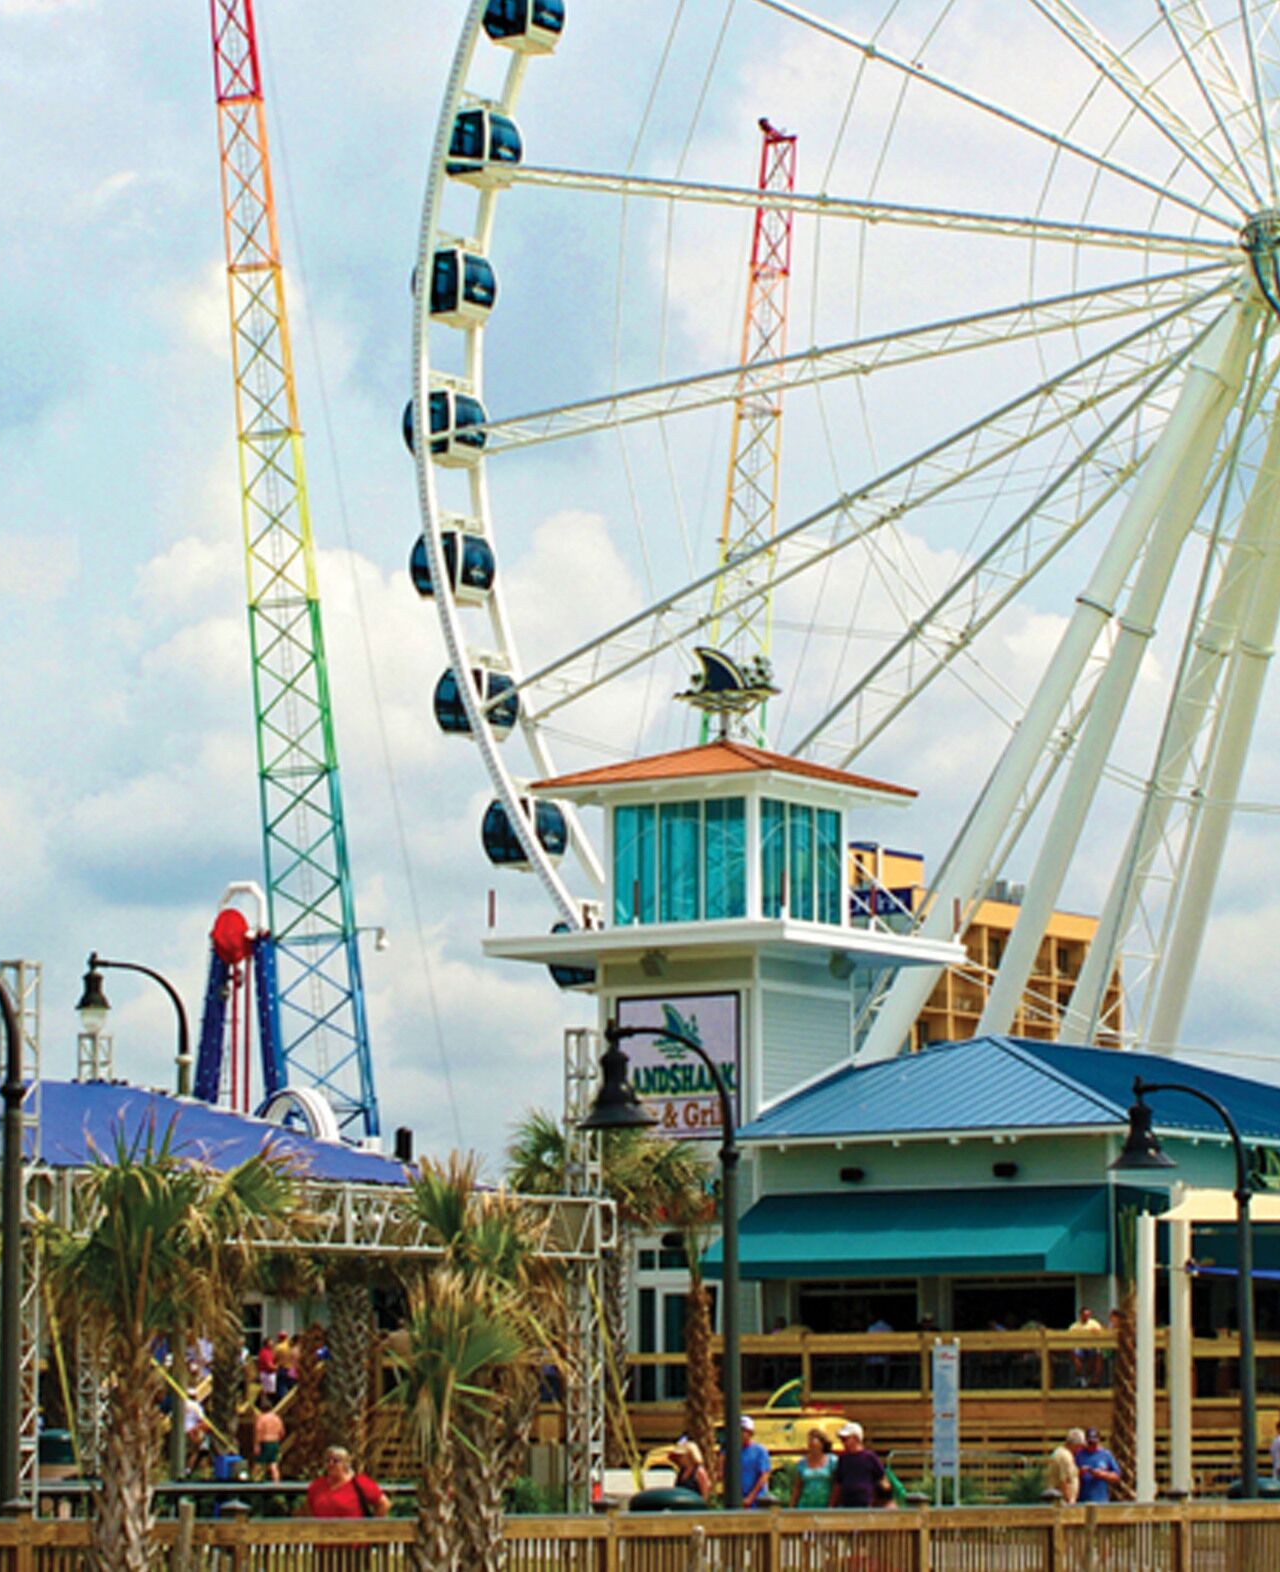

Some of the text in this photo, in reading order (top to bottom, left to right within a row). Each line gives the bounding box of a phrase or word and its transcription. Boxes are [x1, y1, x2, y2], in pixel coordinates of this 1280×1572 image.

[632, 1062, 736, 1093] ANDSHAK
[663, 1102, 678, 1128] &
[683, 1101, 725, 1127] Gril
